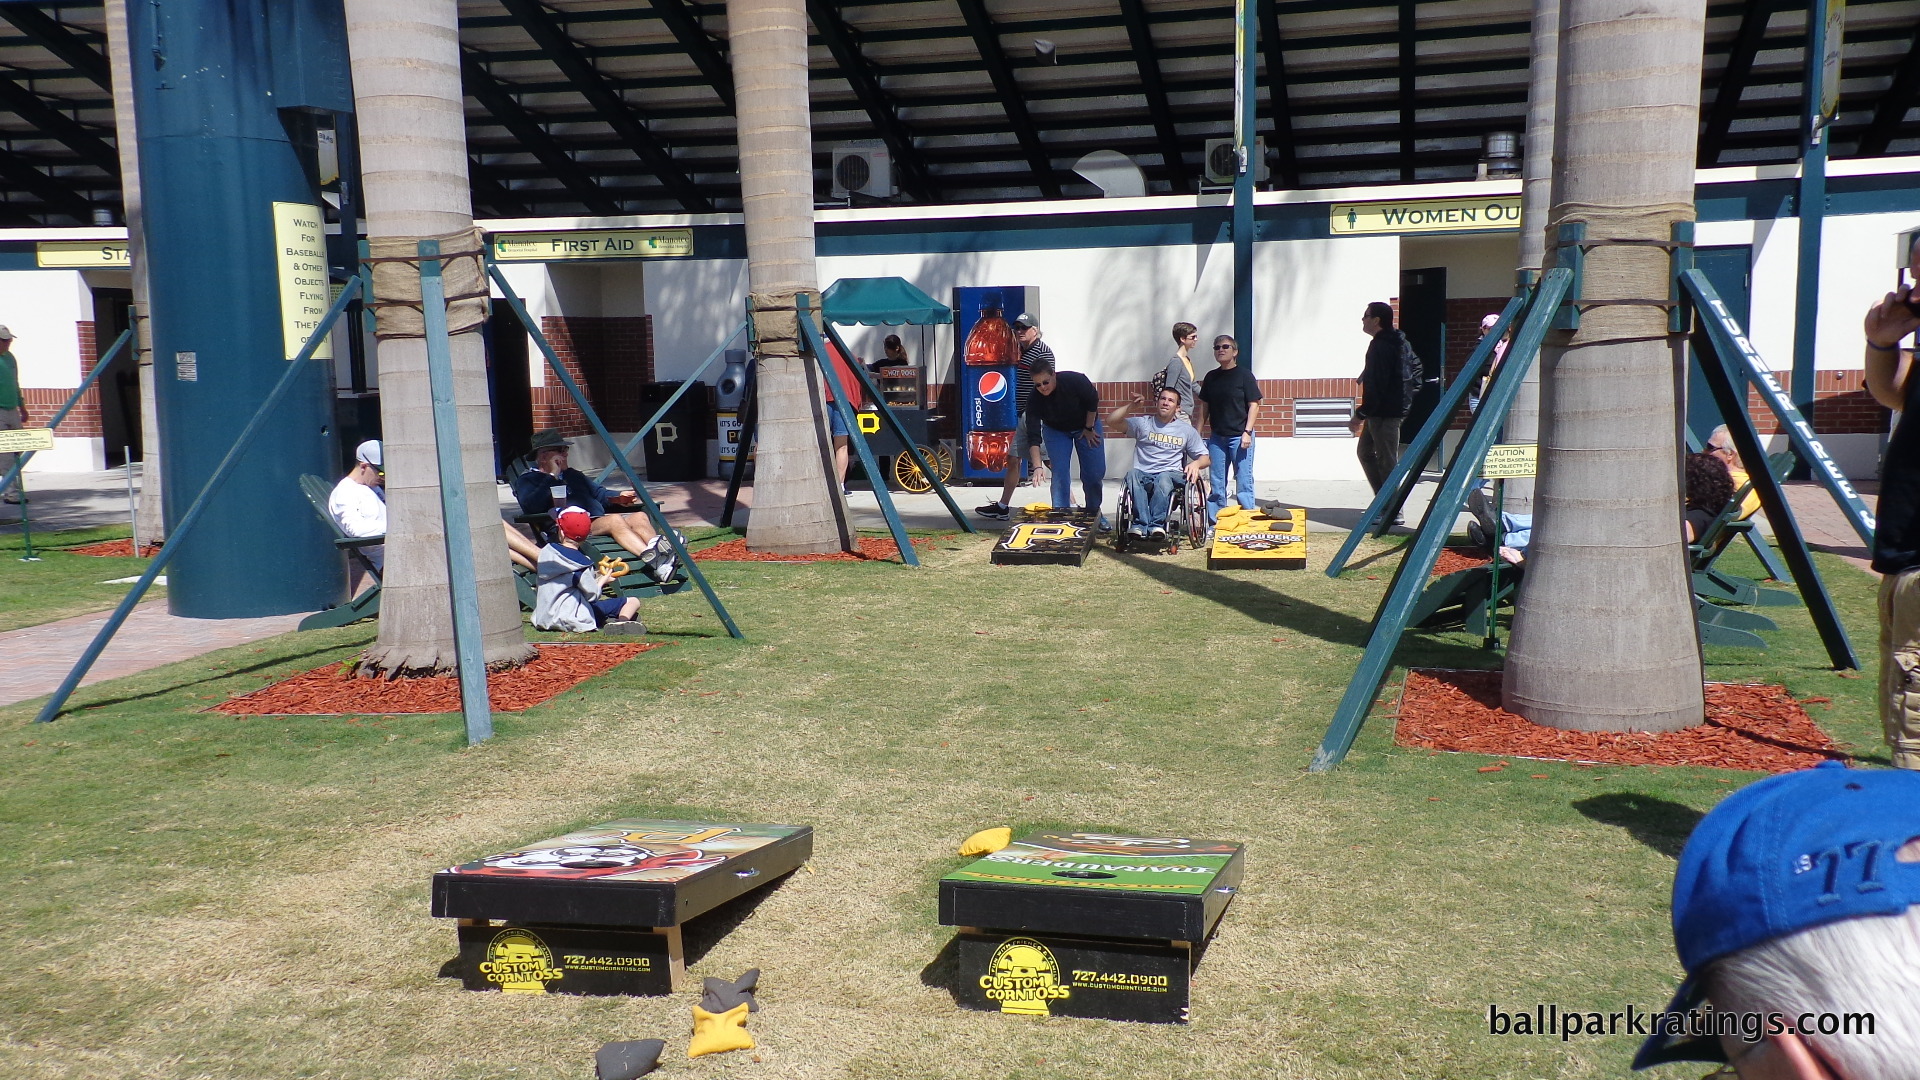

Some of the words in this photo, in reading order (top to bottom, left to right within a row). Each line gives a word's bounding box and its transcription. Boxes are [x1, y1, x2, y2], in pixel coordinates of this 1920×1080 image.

[1382, 207, 1477, 225] WOMEN
[1484, 203, 1520, 221] OU
[293, 218, 319, 229] WATCH
[301, 234, 315, 242] FOR
[551, 238, 599, 252] FIRST
[604, 237, 634, 251] AID
[102, 246, 131, 260] STA
[286, 248, 325, 258] BASEBALLS
[293, 263, 300, 271] &
[301, 263, 323, 272] OTHER
[294, 277, 324, 287] OBJECTS
[300, 292, 324, 301] FLYING
[303, 307, 323, 315] FROM
[294, 320, 312, 329] THE
[1709, 300, 1796, 411] TURNER
[1795, 420, 1858, 499] TREE
[975, 397, 984, 427] pepsi
[479, 961, 541, 974] CUSTOM
[563, 955, 650, 967] 727.442.0900
[486, 967, 564, 983] CORNTOSS
[1072, 970, 1168, 986] 727.442.0900
[979, 974, 1045, 990] CUSTOM
[985, 984, 1070, 1001] CORNTOSS
